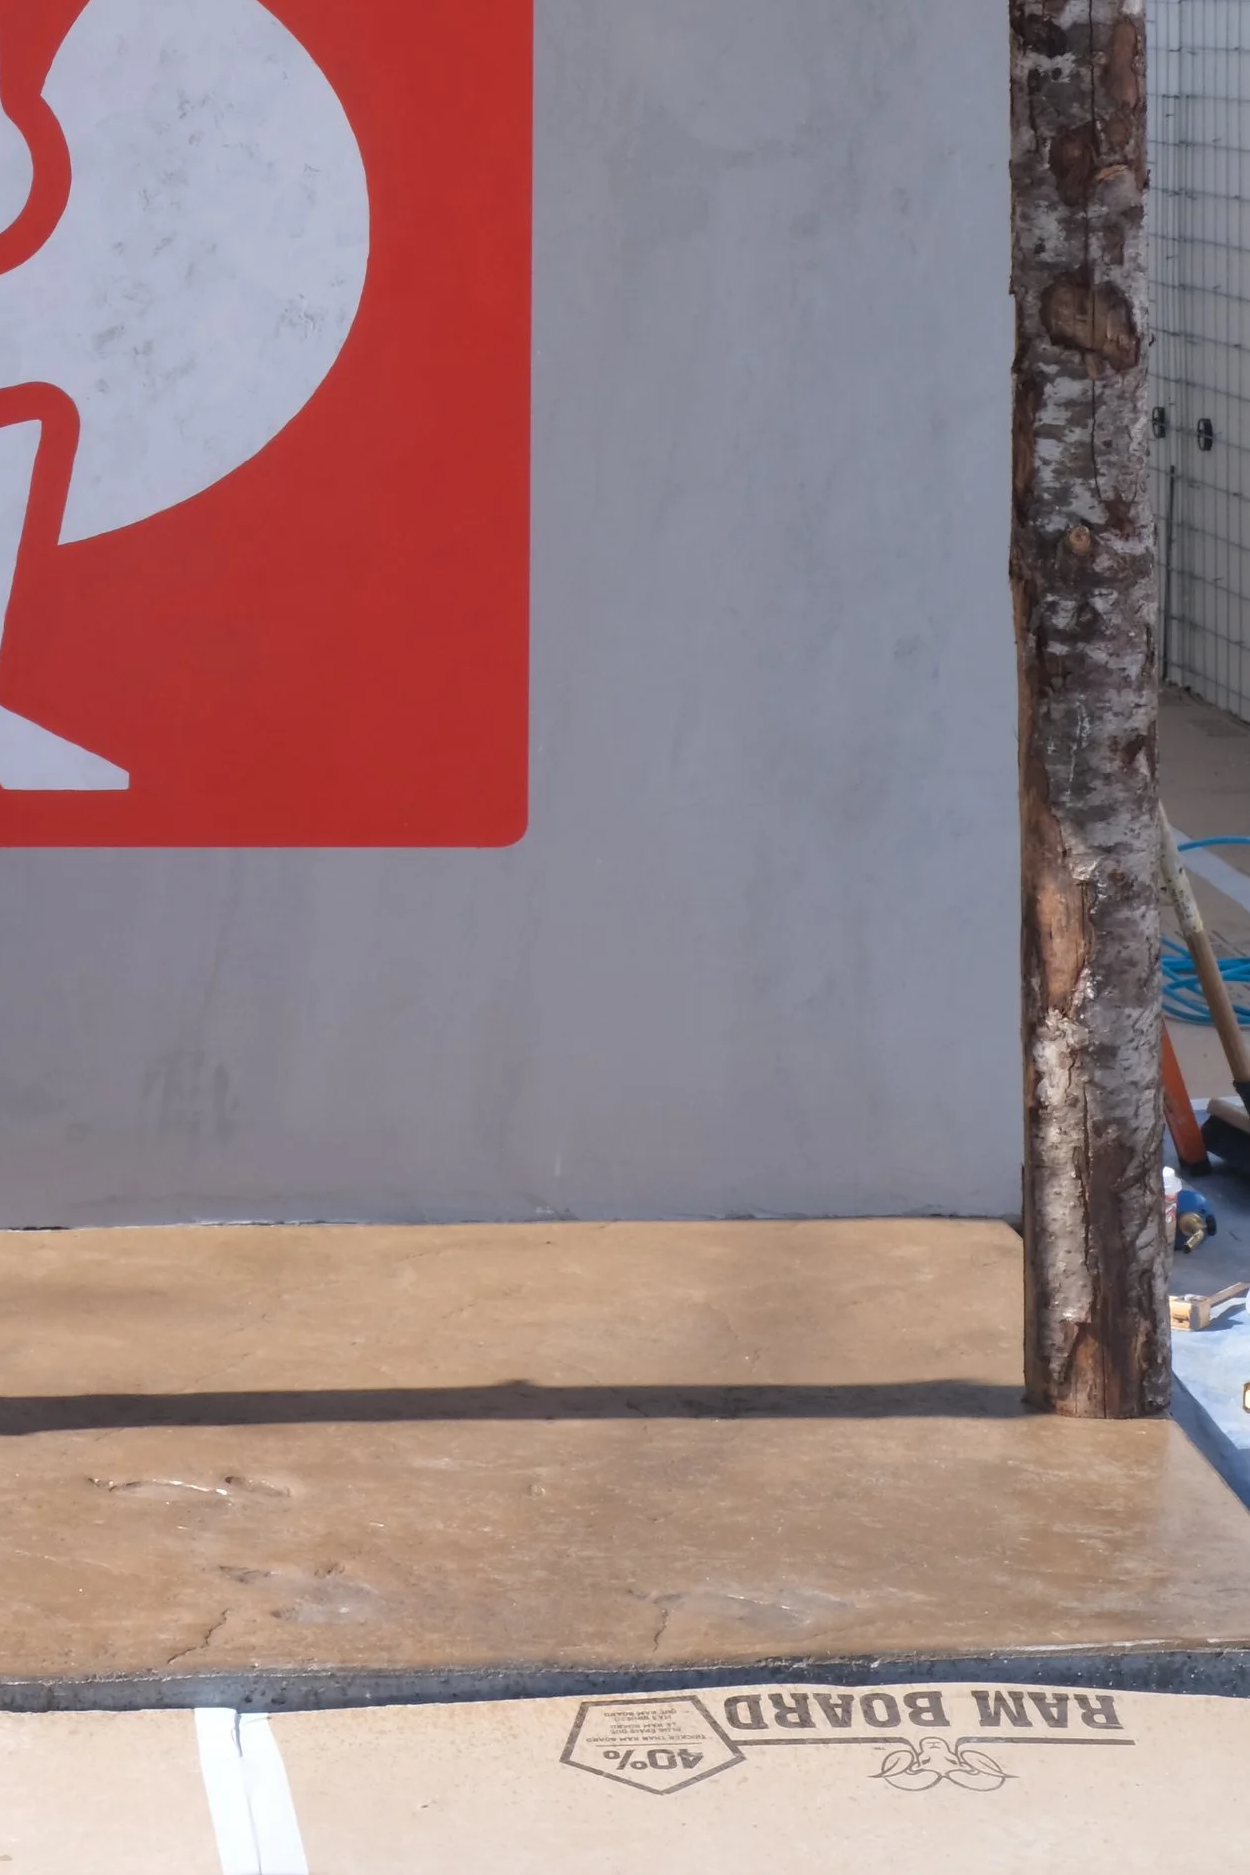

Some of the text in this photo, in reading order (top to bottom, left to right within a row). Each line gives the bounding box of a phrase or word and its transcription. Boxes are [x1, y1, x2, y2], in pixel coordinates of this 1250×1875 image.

[724, 1690, 1124, 1730] RAM BOARD
[603, 1748, 703, 1770] 40%
